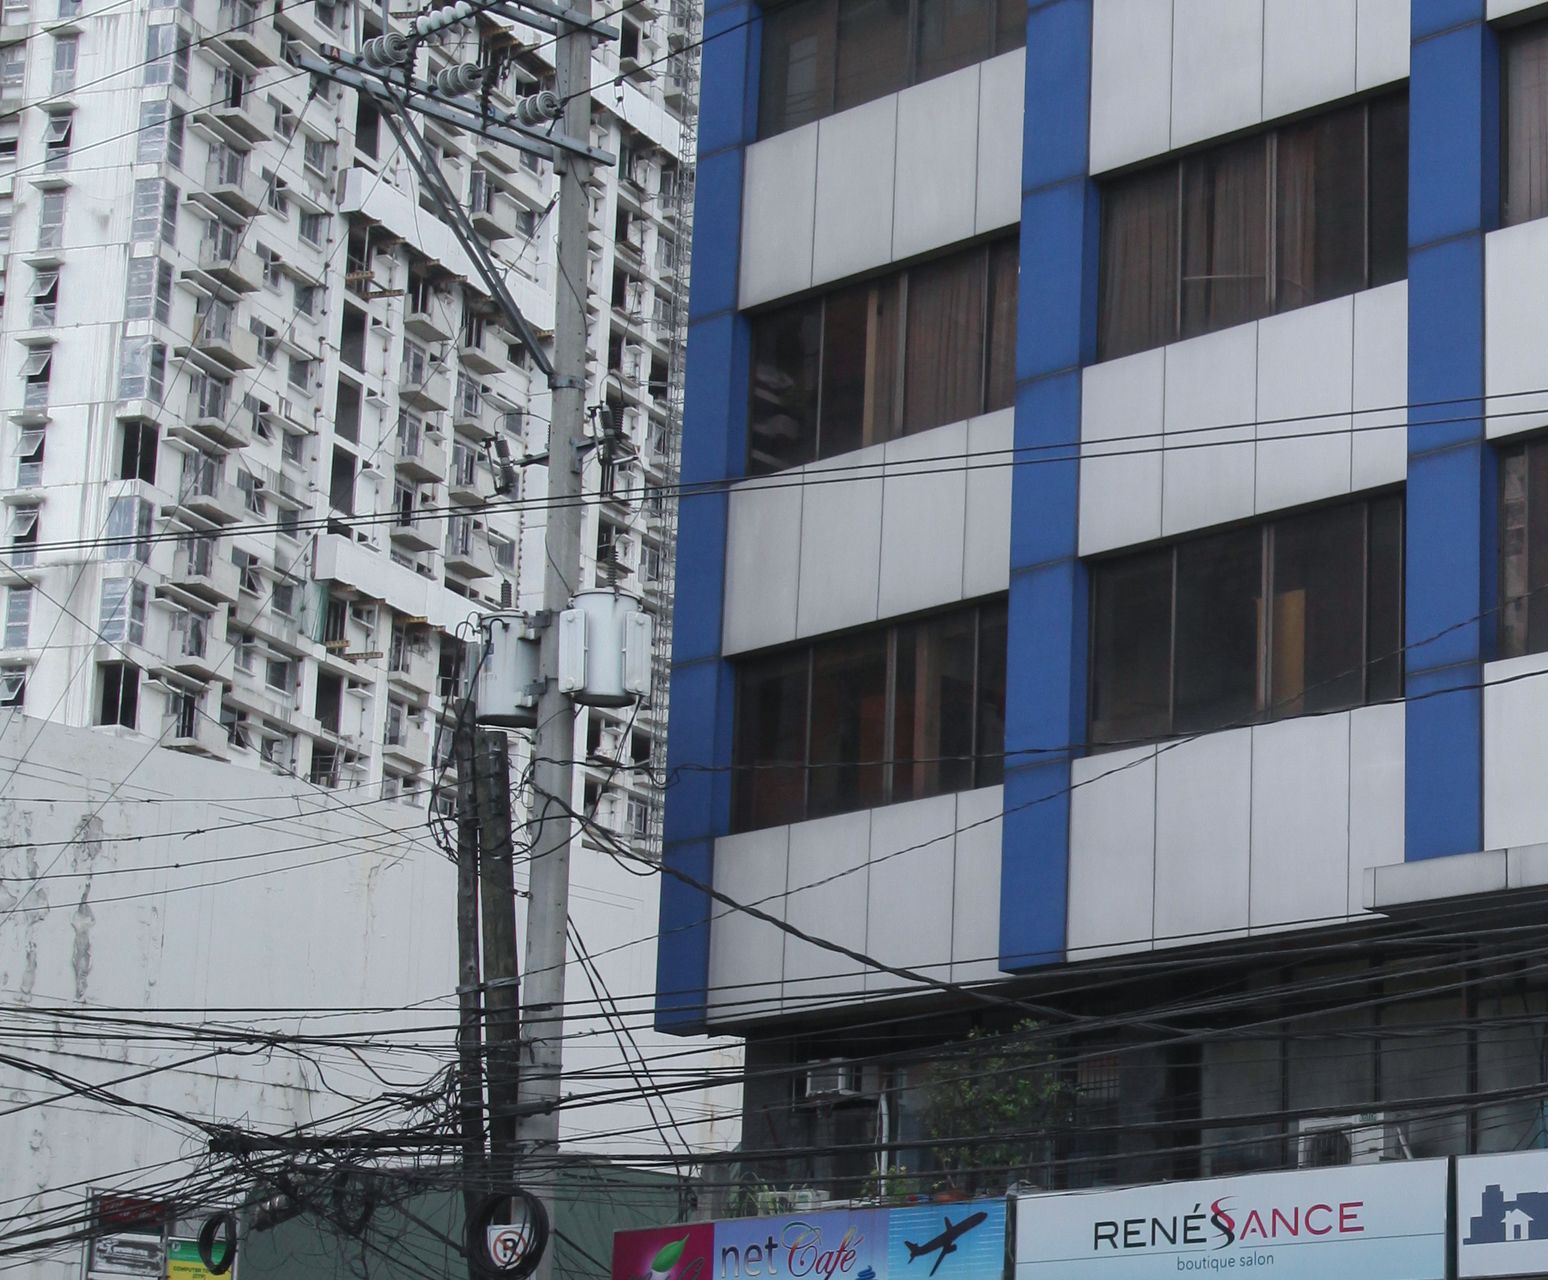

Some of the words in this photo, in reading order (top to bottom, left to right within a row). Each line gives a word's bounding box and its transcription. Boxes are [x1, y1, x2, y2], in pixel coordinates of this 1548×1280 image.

[721, 1236, 778, 1279] net
[781, 1222, 858, 1279] Café
[1176, 1251, 1235, 1273] boutique
[1239, 1250, 1275, 1268] salon
